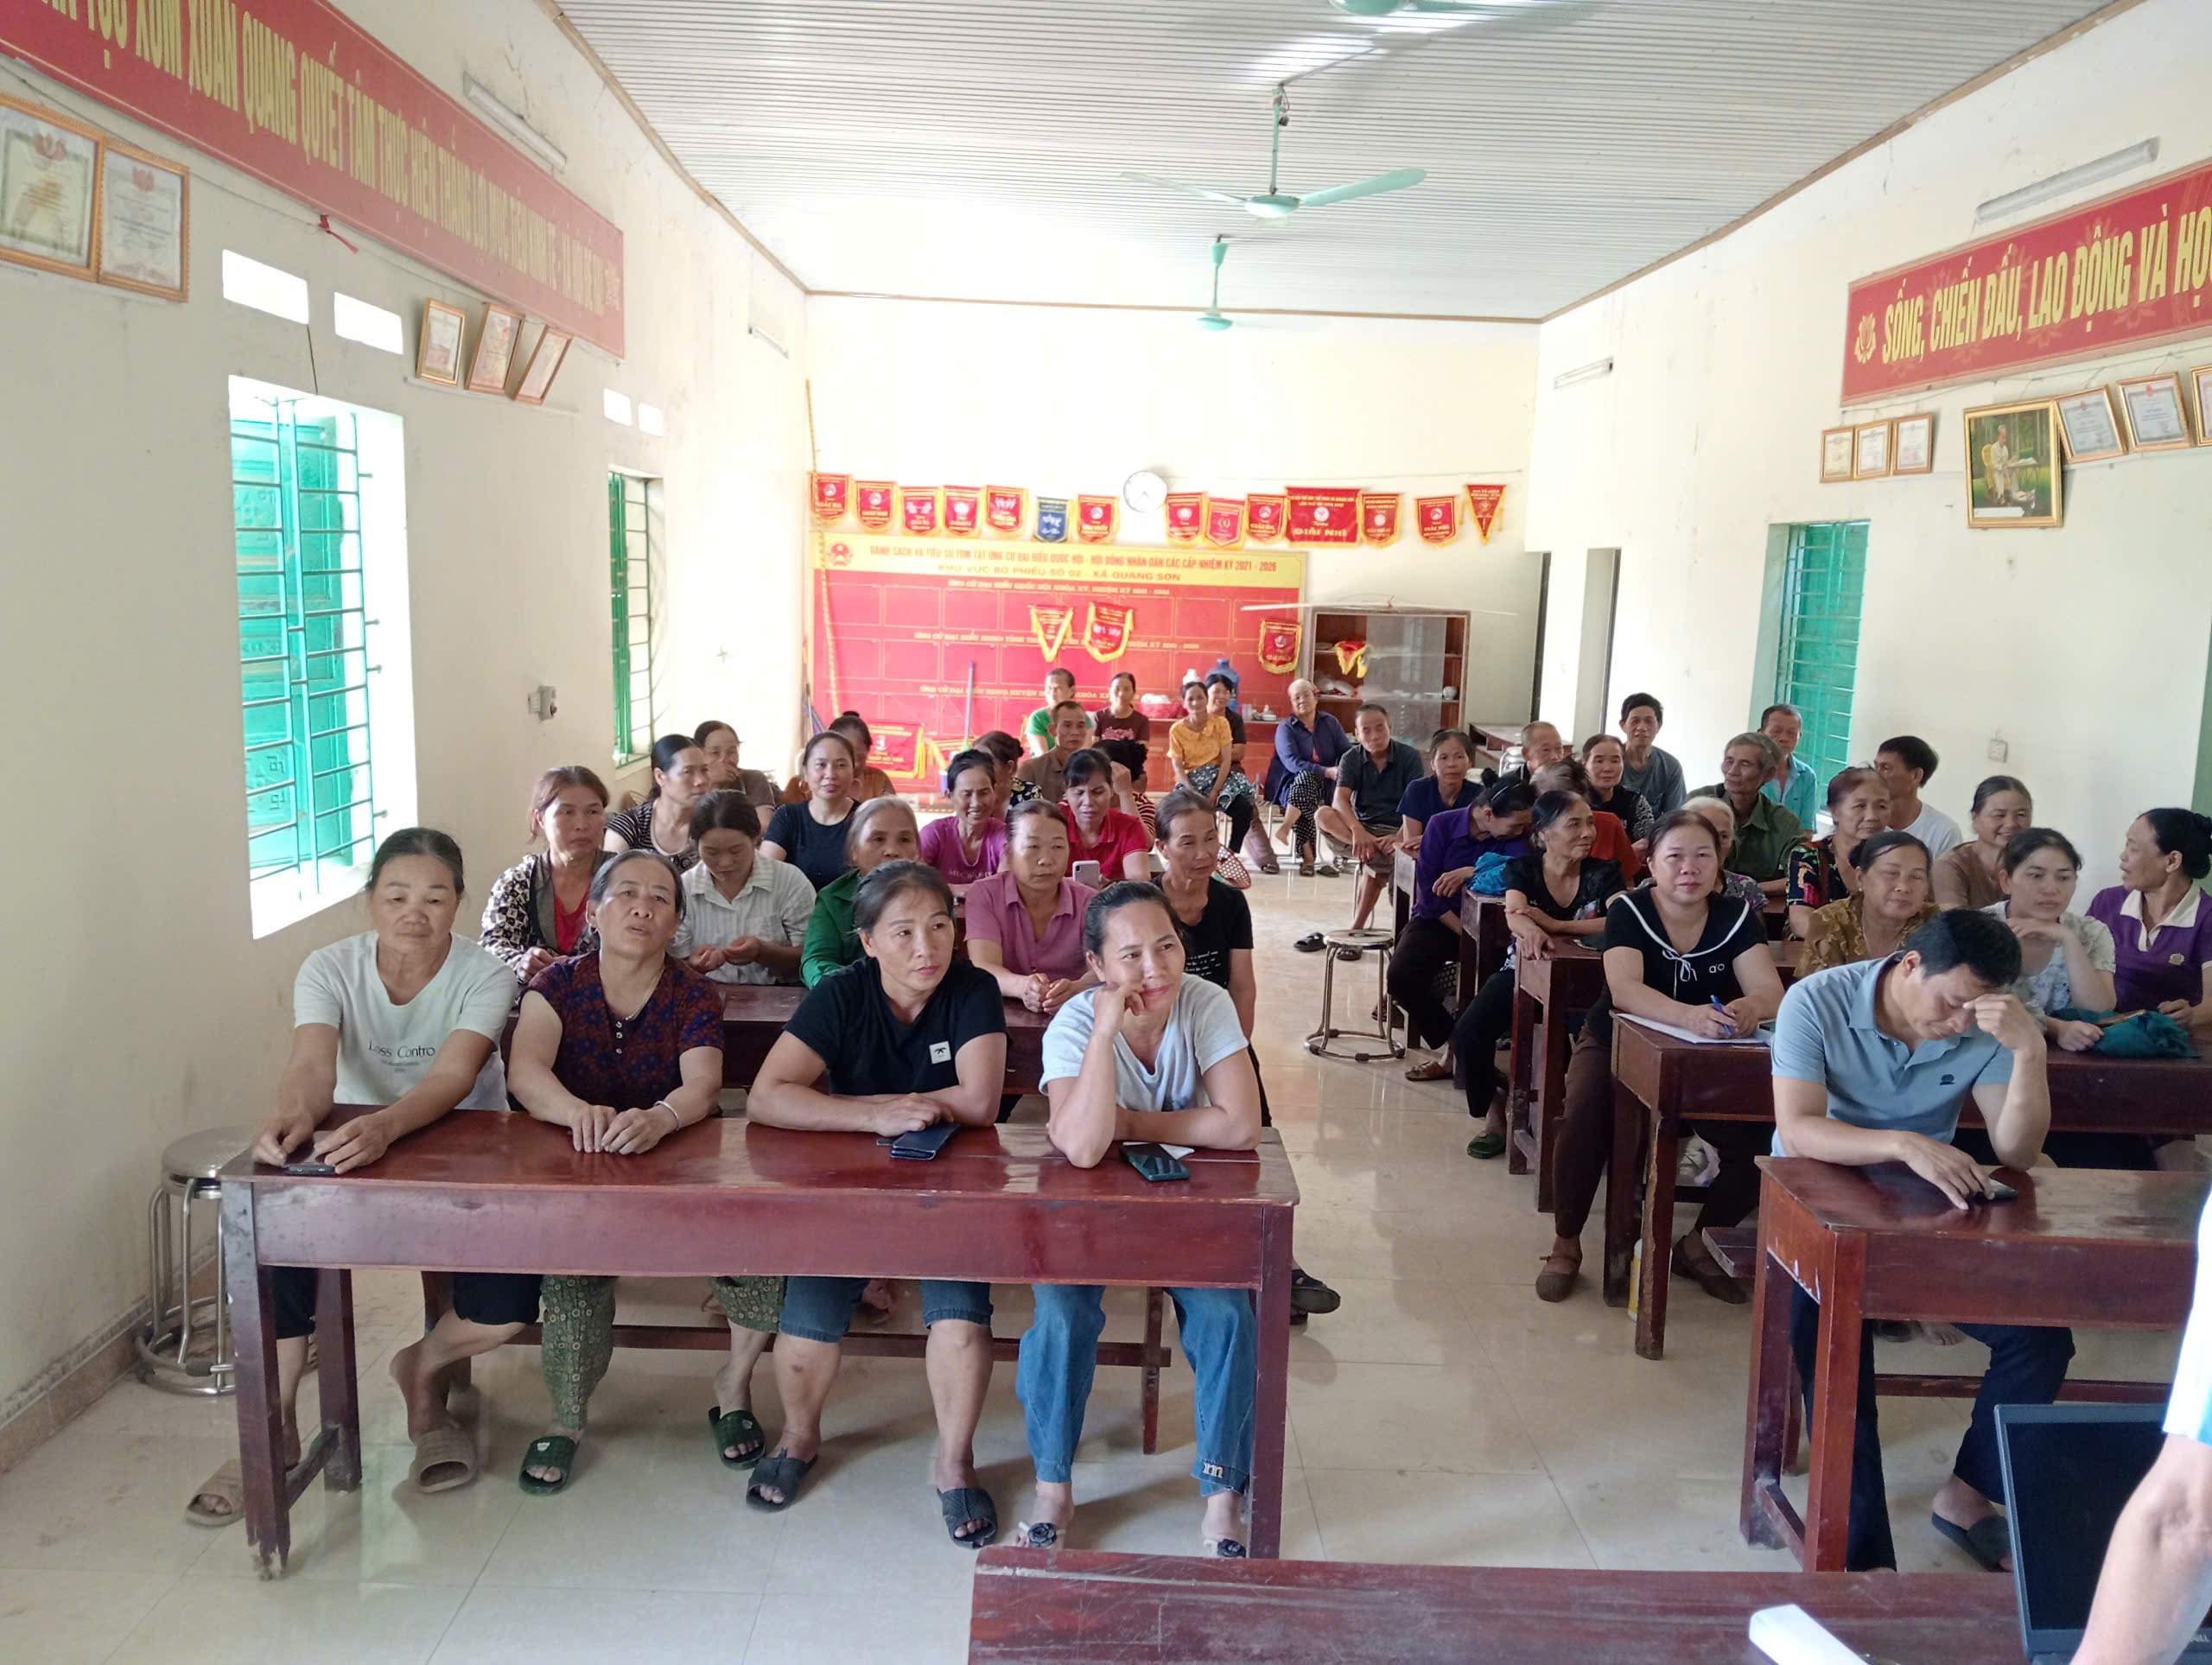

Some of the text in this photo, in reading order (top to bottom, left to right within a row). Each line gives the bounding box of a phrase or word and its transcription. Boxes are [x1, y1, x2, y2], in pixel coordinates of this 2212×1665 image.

[243, 10, 296, 145] QUANG
[301, 41, 344, 171] QUYẾT
[346, 68, 376, 189] TÂM
[1883, 203, 2212, 364] SỐNG, CHIẾN ĐẤU, LAO ĐỘNG VÀ HỌ
[1112, 572, 1154, 581] QUANG
